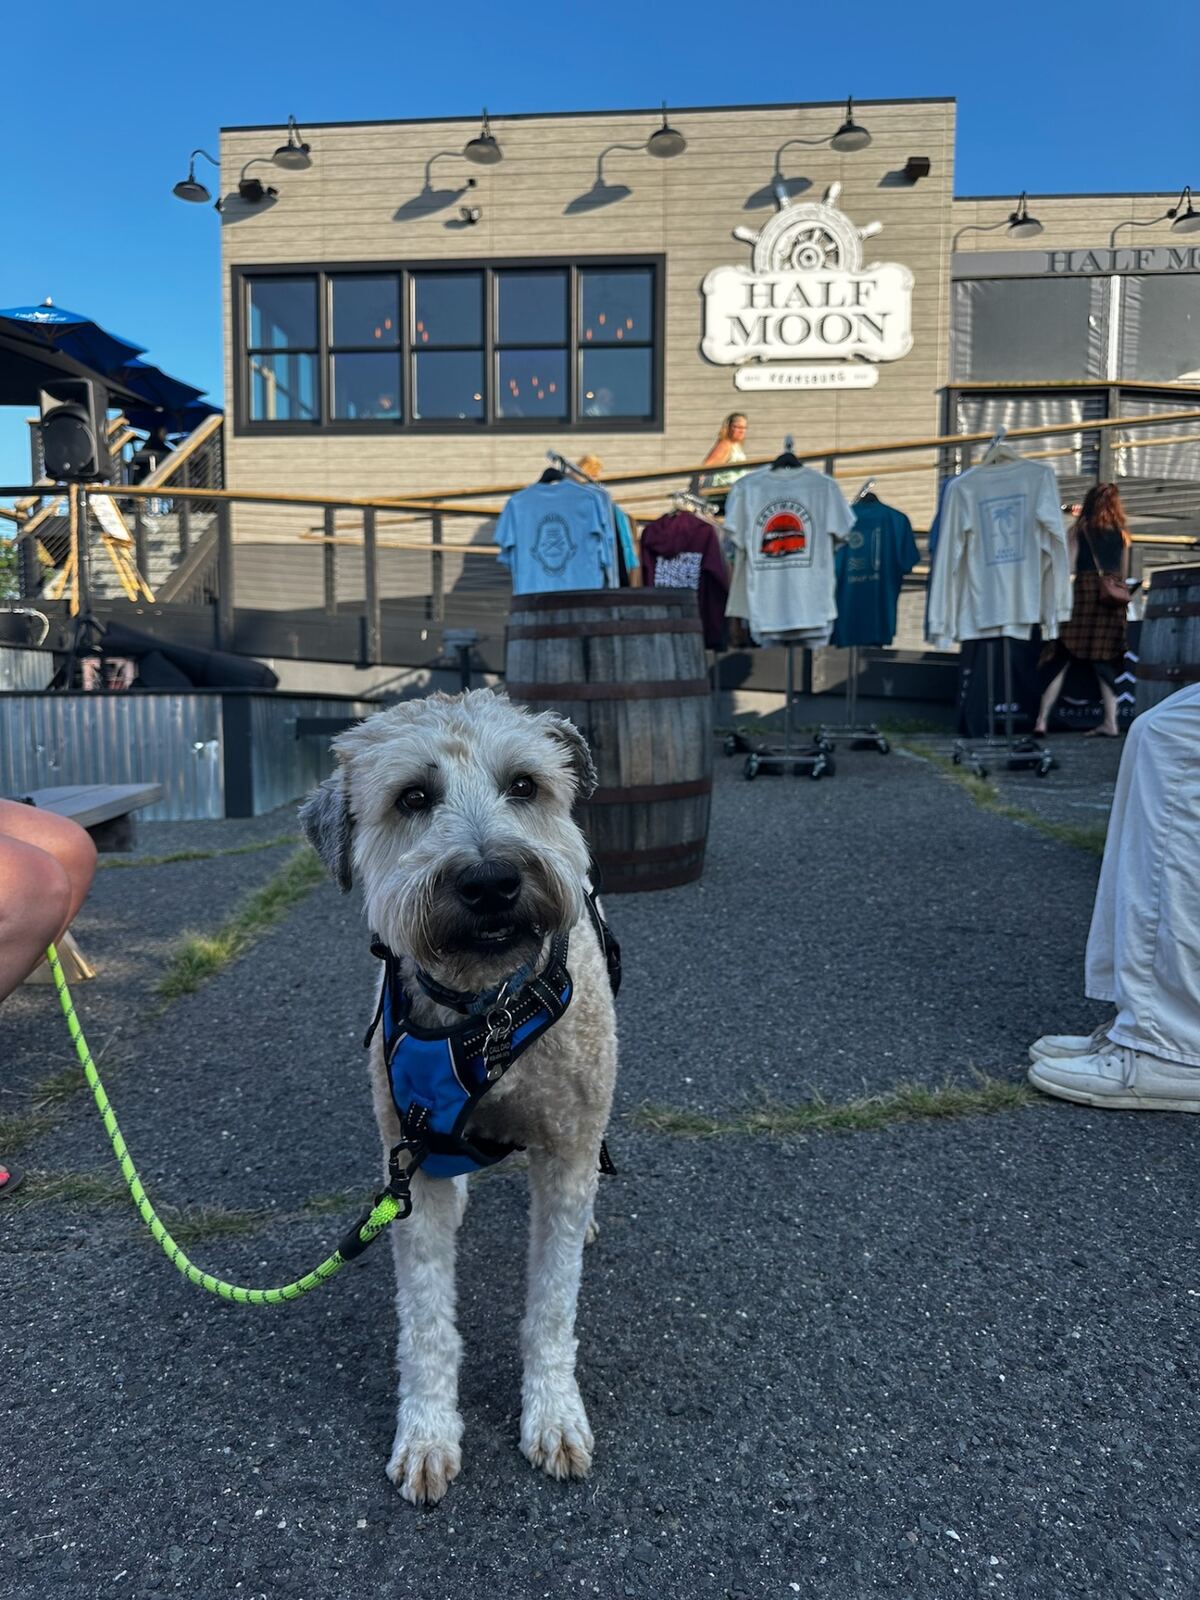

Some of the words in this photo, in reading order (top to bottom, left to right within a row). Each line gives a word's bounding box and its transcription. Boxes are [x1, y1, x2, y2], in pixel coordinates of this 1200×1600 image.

[1044, 249, 1155, 273] HALF
[1166, 247, 1200, 271] M
[741, 280, 877, 309] HALF
[725, 313, 892, 346] MOON
